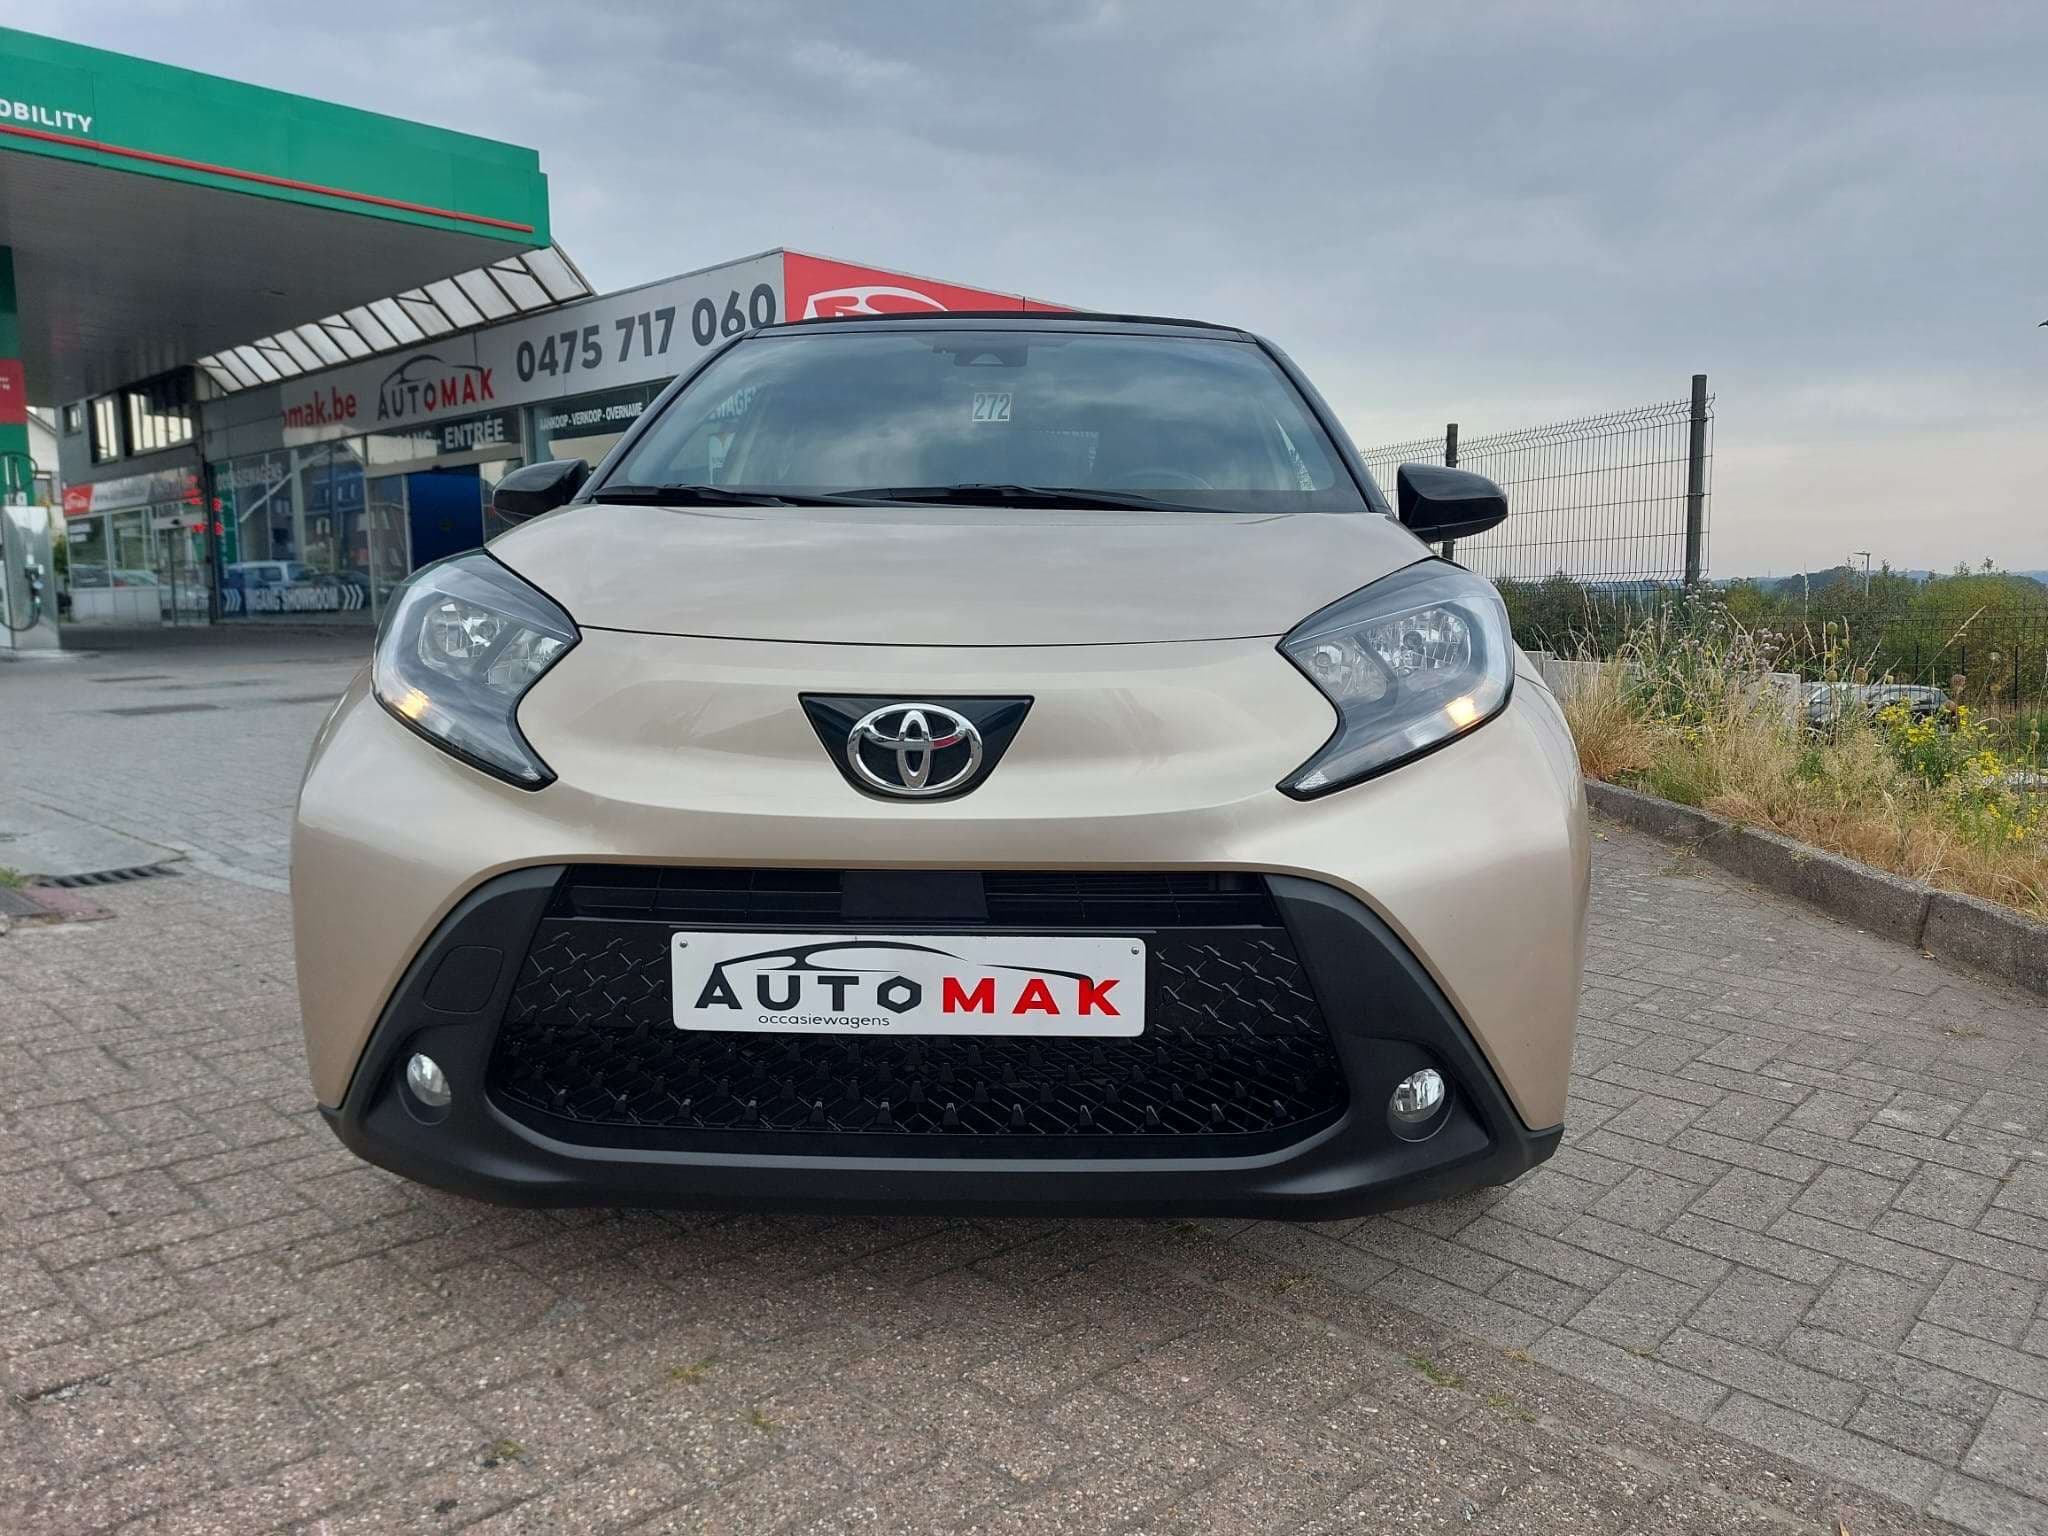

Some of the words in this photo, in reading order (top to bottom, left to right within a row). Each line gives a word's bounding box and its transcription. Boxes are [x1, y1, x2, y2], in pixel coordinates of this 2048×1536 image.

[0, 98, 92, 133] OBILITY
[516, 325, 602, 382] 0475
[615, 306, 676, 362] 717
[692, 283, 776, 346] 060
[377, 368, 494, 422] AUTOMAK
[974, 393, 1010, 420] 272
[571, 409, 602, 425] VERKOOP
[605, 402, 643, 420] OVERNAME
[444, 416, 505, 449] ENTRÉE
[757, 1012, 891, 1029] occasiewagens
